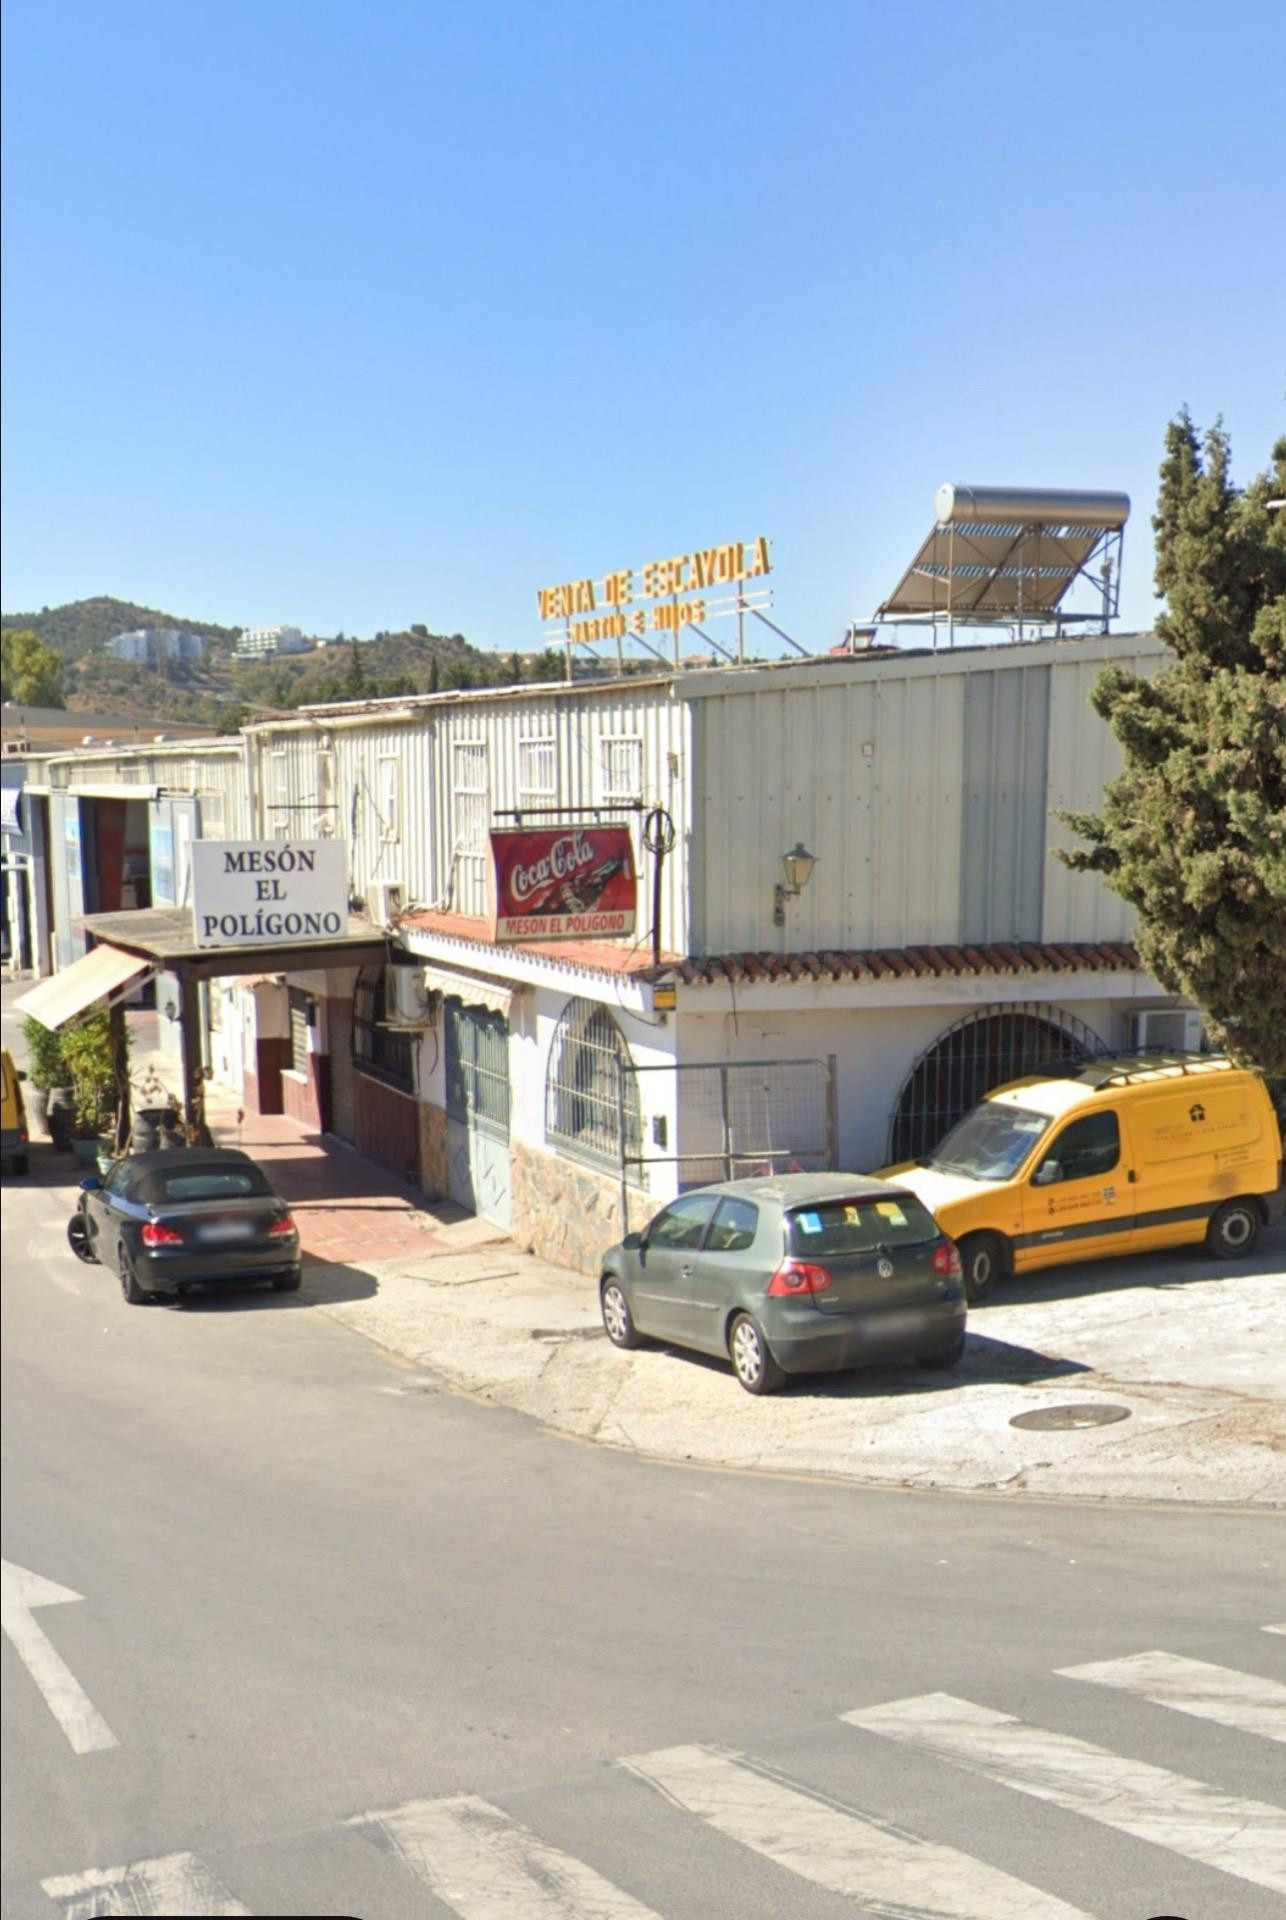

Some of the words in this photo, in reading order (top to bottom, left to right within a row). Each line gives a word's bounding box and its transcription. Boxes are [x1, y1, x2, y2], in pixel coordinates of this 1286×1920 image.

[537, 579, 595, 620] VENTA
[602, 570, 633, 606] DE
[641, 536, 771, 598] ESCAYOLA
[223, 844, 316, 873] MESÓN
[255, 880, 287, 901] EL
[203, 908, 341, 937] POLÍGONO
[506, 917, 547, 936] MESON
[549, 918, 563, 933] EL
[566, 914, 625, 931] POLIGONO
